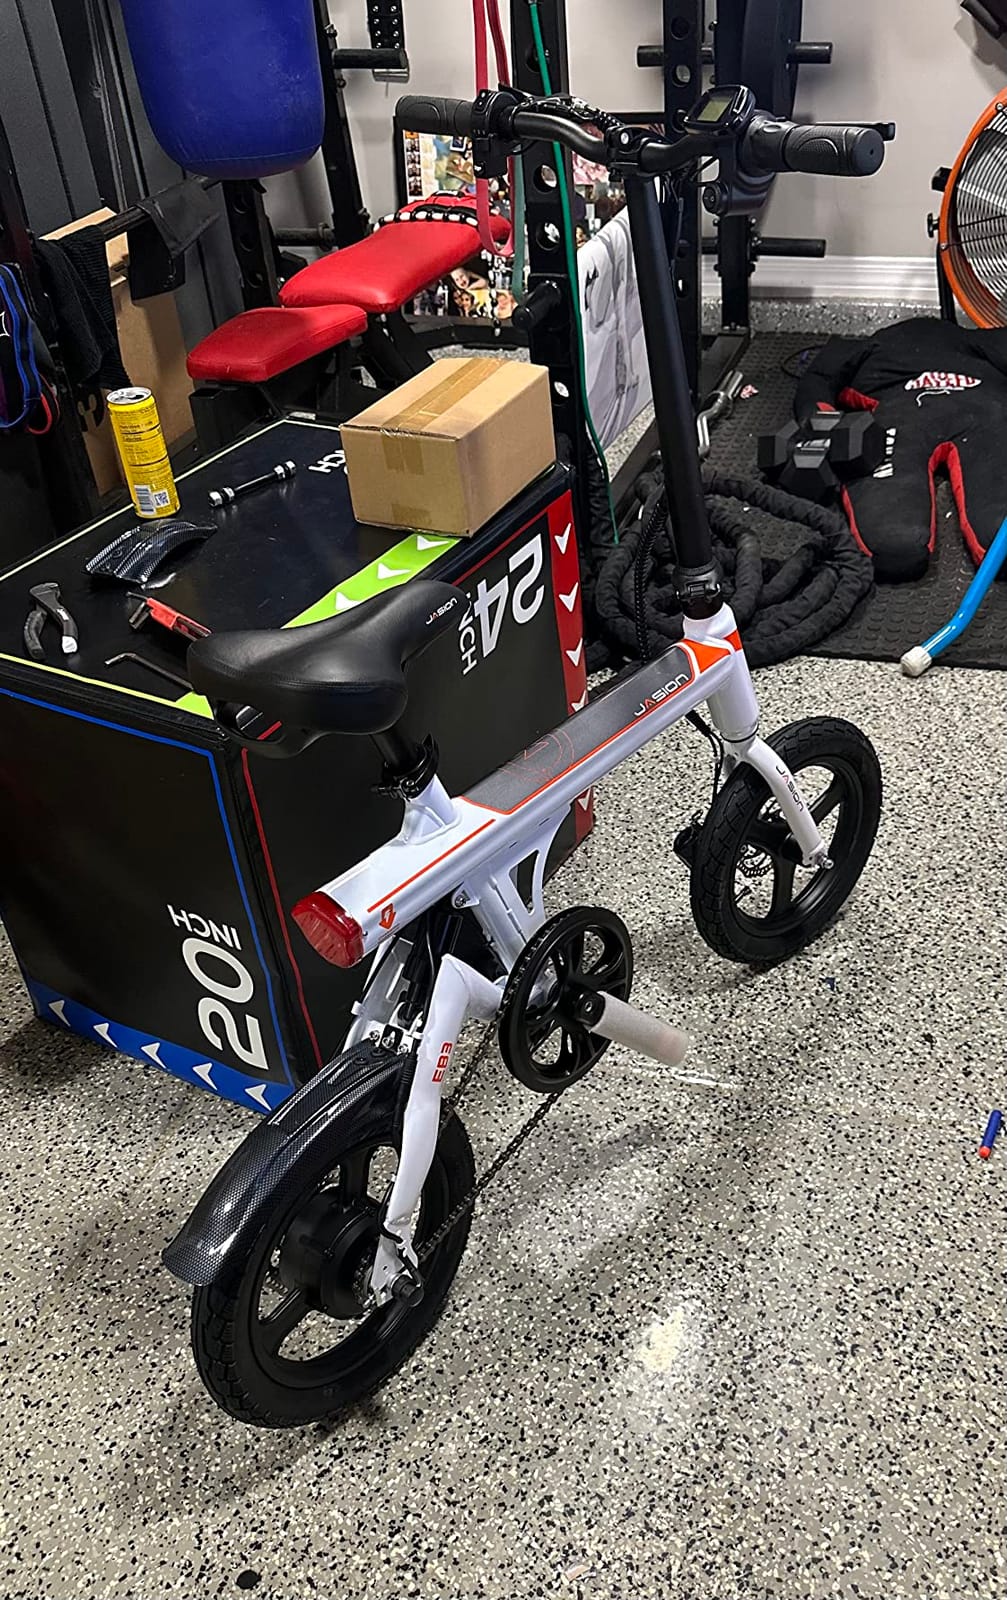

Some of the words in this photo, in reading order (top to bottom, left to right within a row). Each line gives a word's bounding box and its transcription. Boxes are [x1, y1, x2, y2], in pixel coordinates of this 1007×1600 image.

[425, 597, 458, 625] JASION
[474, 533, 544, 658] 24
[634, 673, 689, 717] JASION
[775, 765, 804, 813] JASION
[167, 904, 242, 950] INCH
[182, 937, 269, 1070] 20
[431, 1041, 453, 1082] EB3
